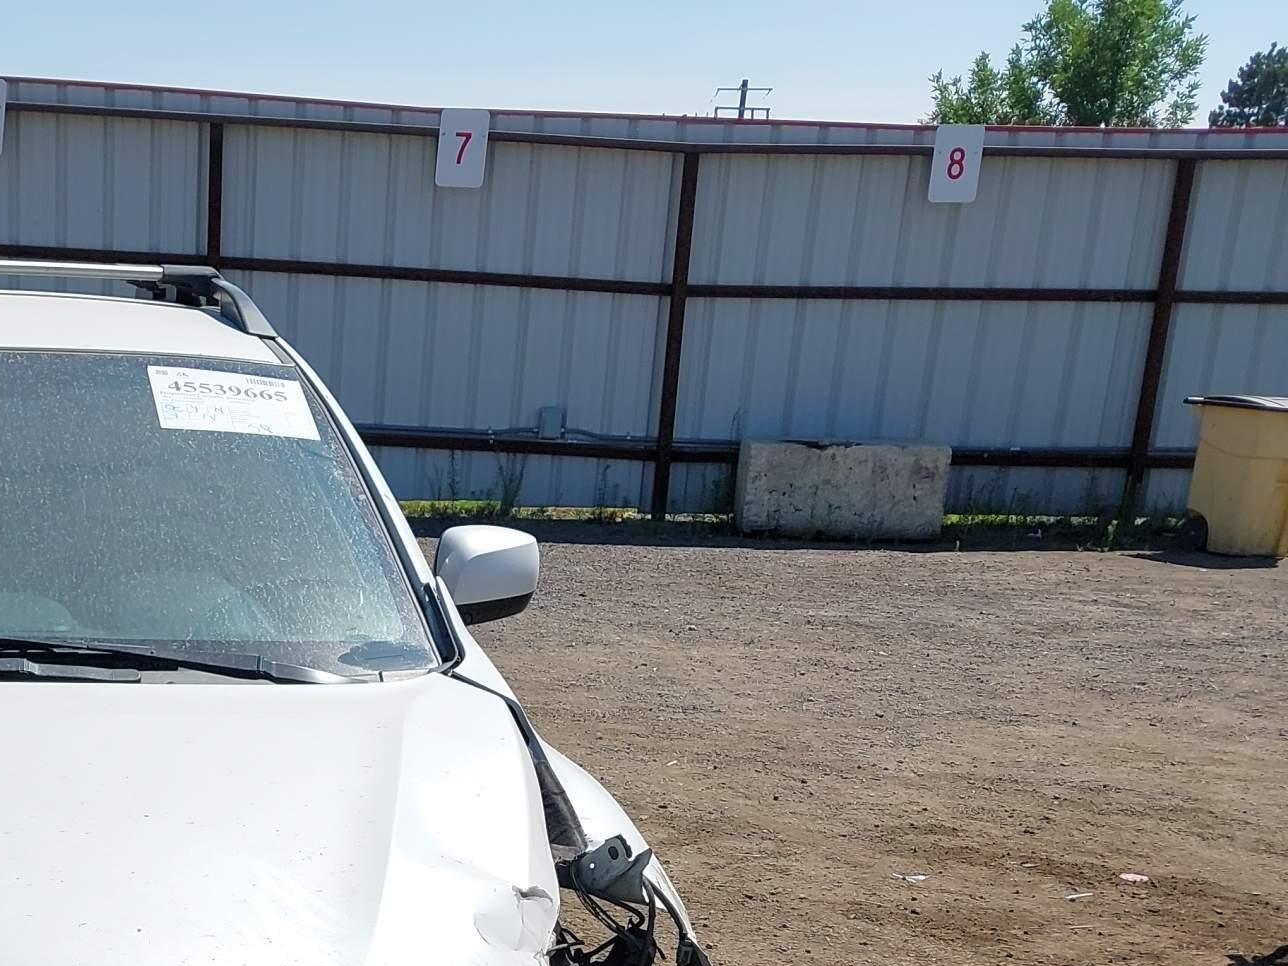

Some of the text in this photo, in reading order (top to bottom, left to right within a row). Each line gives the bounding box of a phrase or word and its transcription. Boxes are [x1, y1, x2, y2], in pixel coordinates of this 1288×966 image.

[455, 131, 472, 163] 7
[947, 147, 965, 180] 8
[168, 380, 288, 402] 45539665
